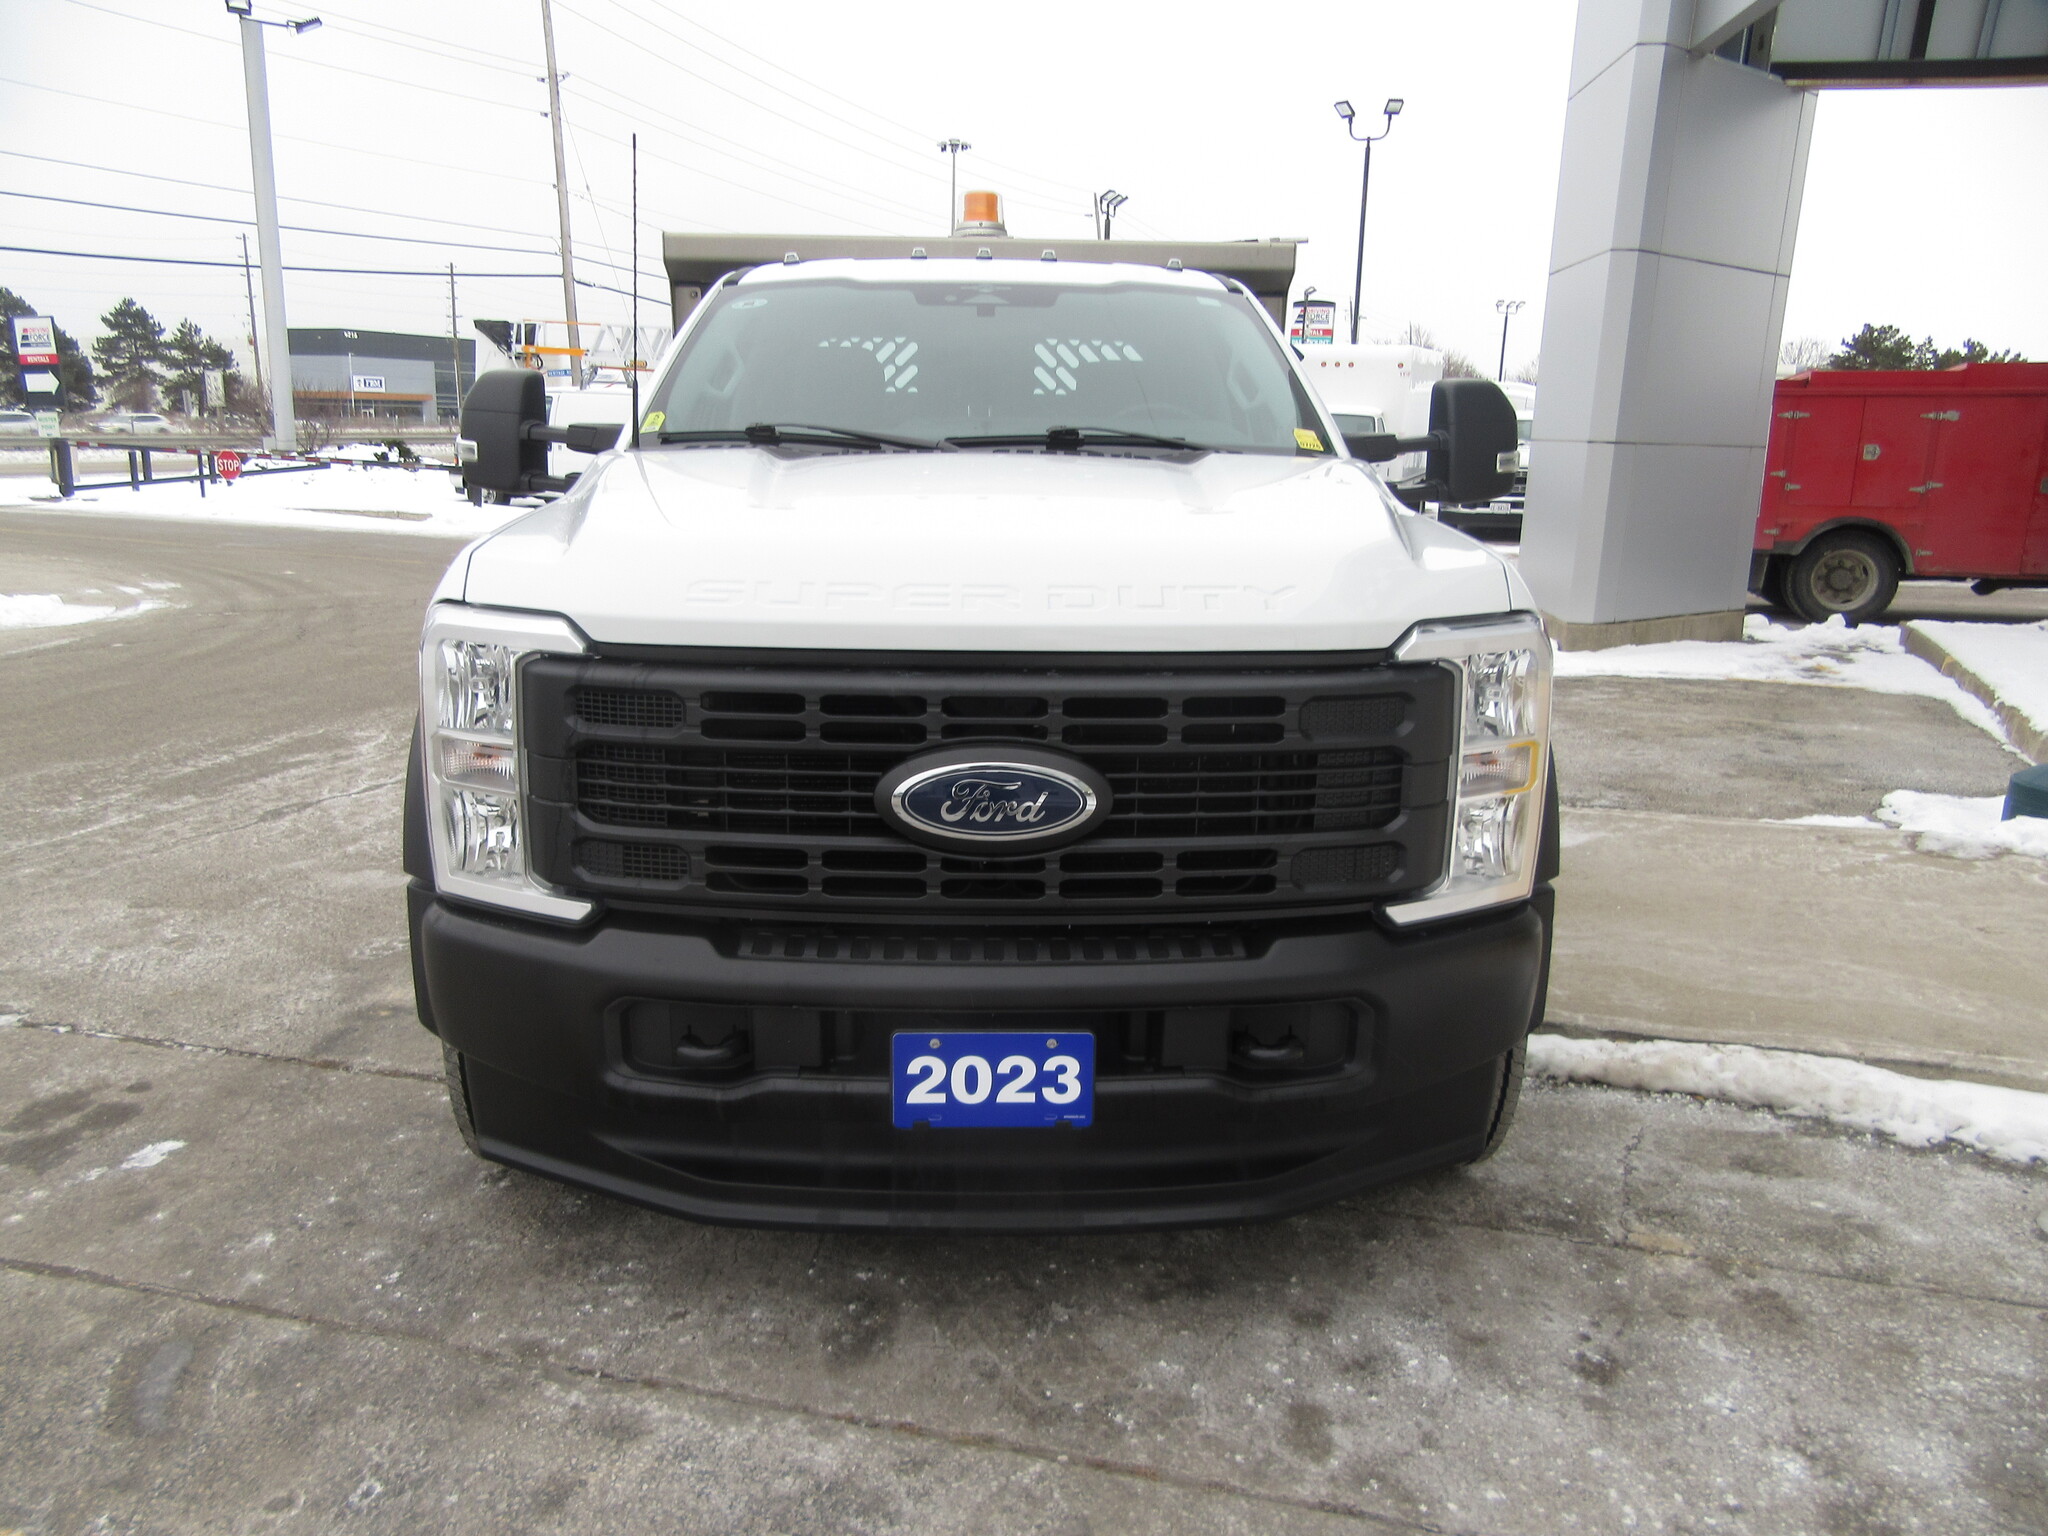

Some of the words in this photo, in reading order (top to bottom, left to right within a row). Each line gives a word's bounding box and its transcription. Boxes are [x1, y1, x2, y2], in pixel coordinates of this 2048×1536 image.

[27, 355, 50, 363] RENTALS
[218, 459, 240, 472] STOP
[685, 580, 1021, 612] SUPER
[1047, 585, 1298, 611] DUTY
[940, 778, 1049, 824] Ford
[906, 1055, 1082, 1104] 2023
